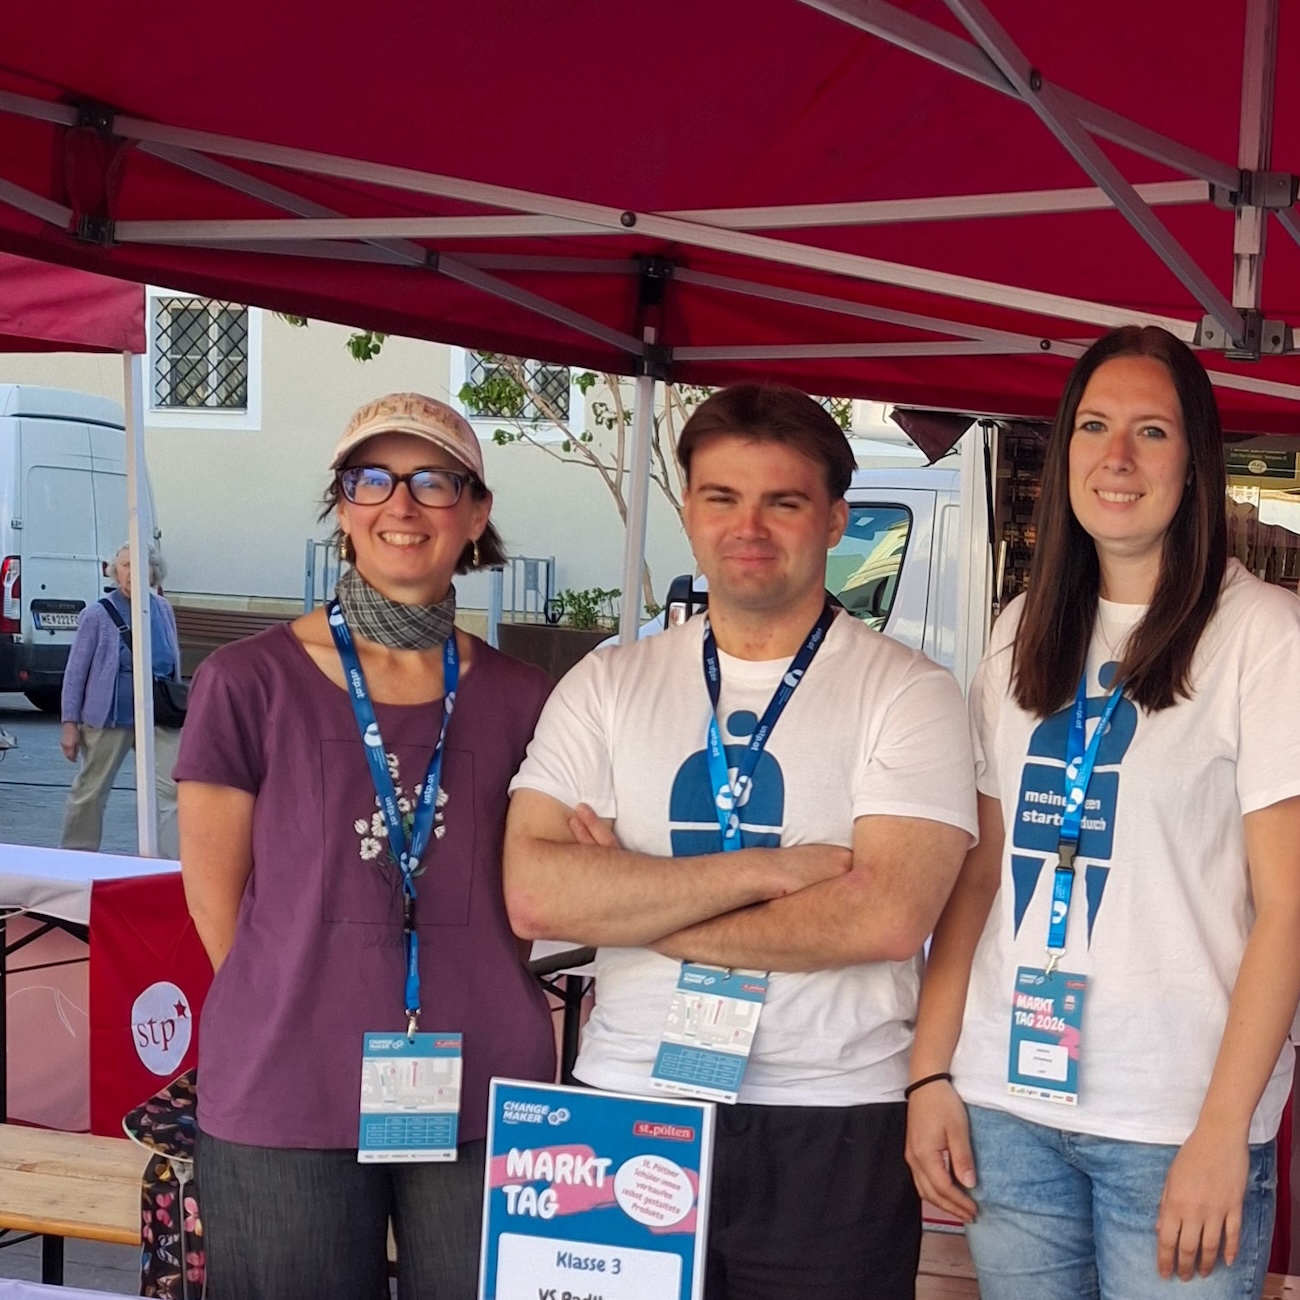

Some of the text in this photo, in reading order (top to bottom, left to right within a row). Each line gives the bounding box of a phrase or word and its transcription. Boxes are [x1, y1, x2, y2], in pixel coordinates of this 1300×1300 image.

[350, 668, 366, 699] ustp.at
[750, 725, 768, 752] ustp.at
[423, 773, 435, 805] ustp.at
[385, 796, 399, 827] ustp.at
[1016, 994, 1055, 1013] MARKT
[1015, 1011, 1066, 1032] TAG 2026
[502, 1110, 543, 1124] MAKER
[503, 1100, 549, 1115] CHANGE
[506, 1147, 613, 1189] MARKT
[502, 1184, 559, 1220] TAG
[556, 1251, 622, 1275] Klasse 3
